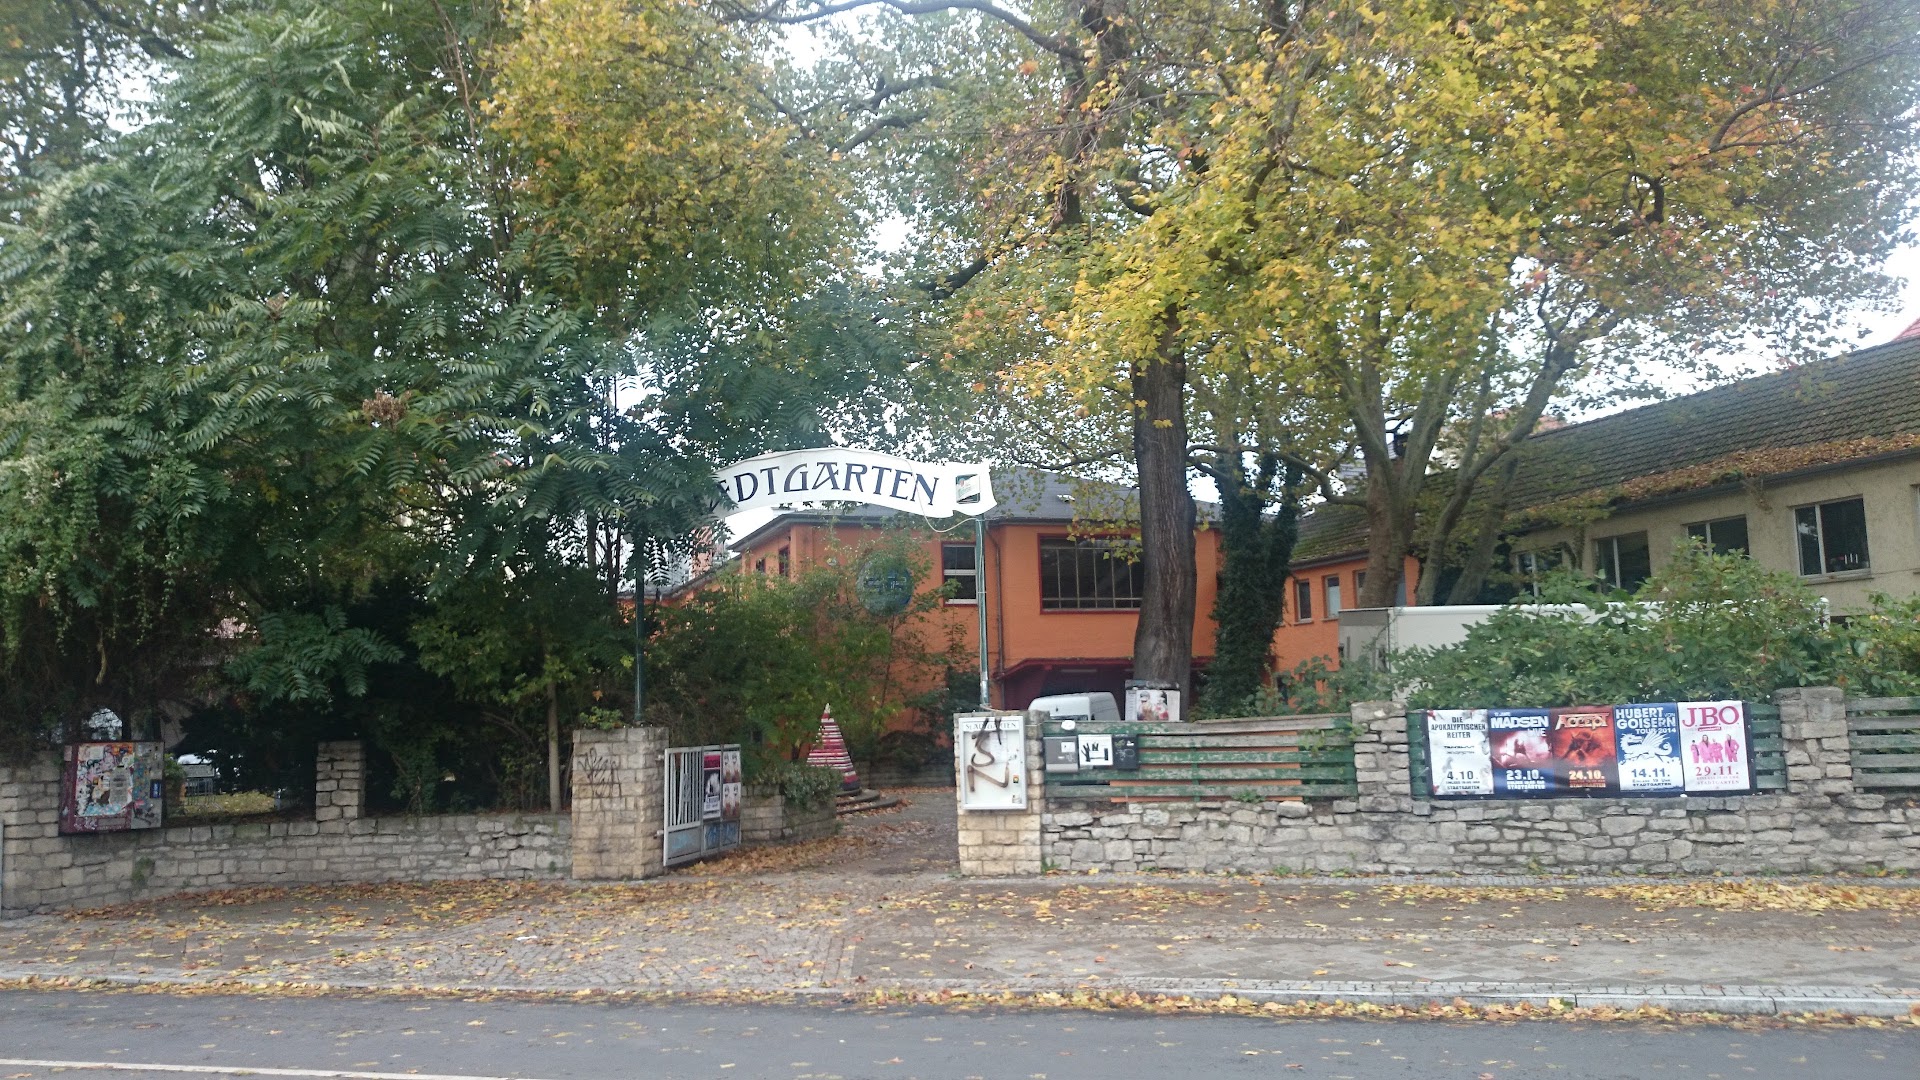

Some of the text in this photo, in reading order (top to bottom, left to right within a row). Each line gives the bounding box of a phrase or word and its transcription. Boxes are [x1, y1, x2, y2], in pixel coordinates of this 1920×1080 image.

[1615, 707, 1664, 719] HUBERT
[965, 722, 1016, 730] STADGTEN
[1431, 723, 1486, 731] APOKALYPTISCHEN
[1490, 716, 1549, 729] MADSEN
[1616, 717, 1676, 729] GOISERN
[1446, 731, 1471, 739] REITER
[1527, 728, 1547, 737] LIVE
[1446, 770, 1479, 780] 4.10.
[1506, 769, 1544, 780] 23.10.
[1568, 769, 1605, 780] 24.10.
[1631, 767, 1670, 778] 14.11.
[1695, 765, 1739, 776] 29.11.
